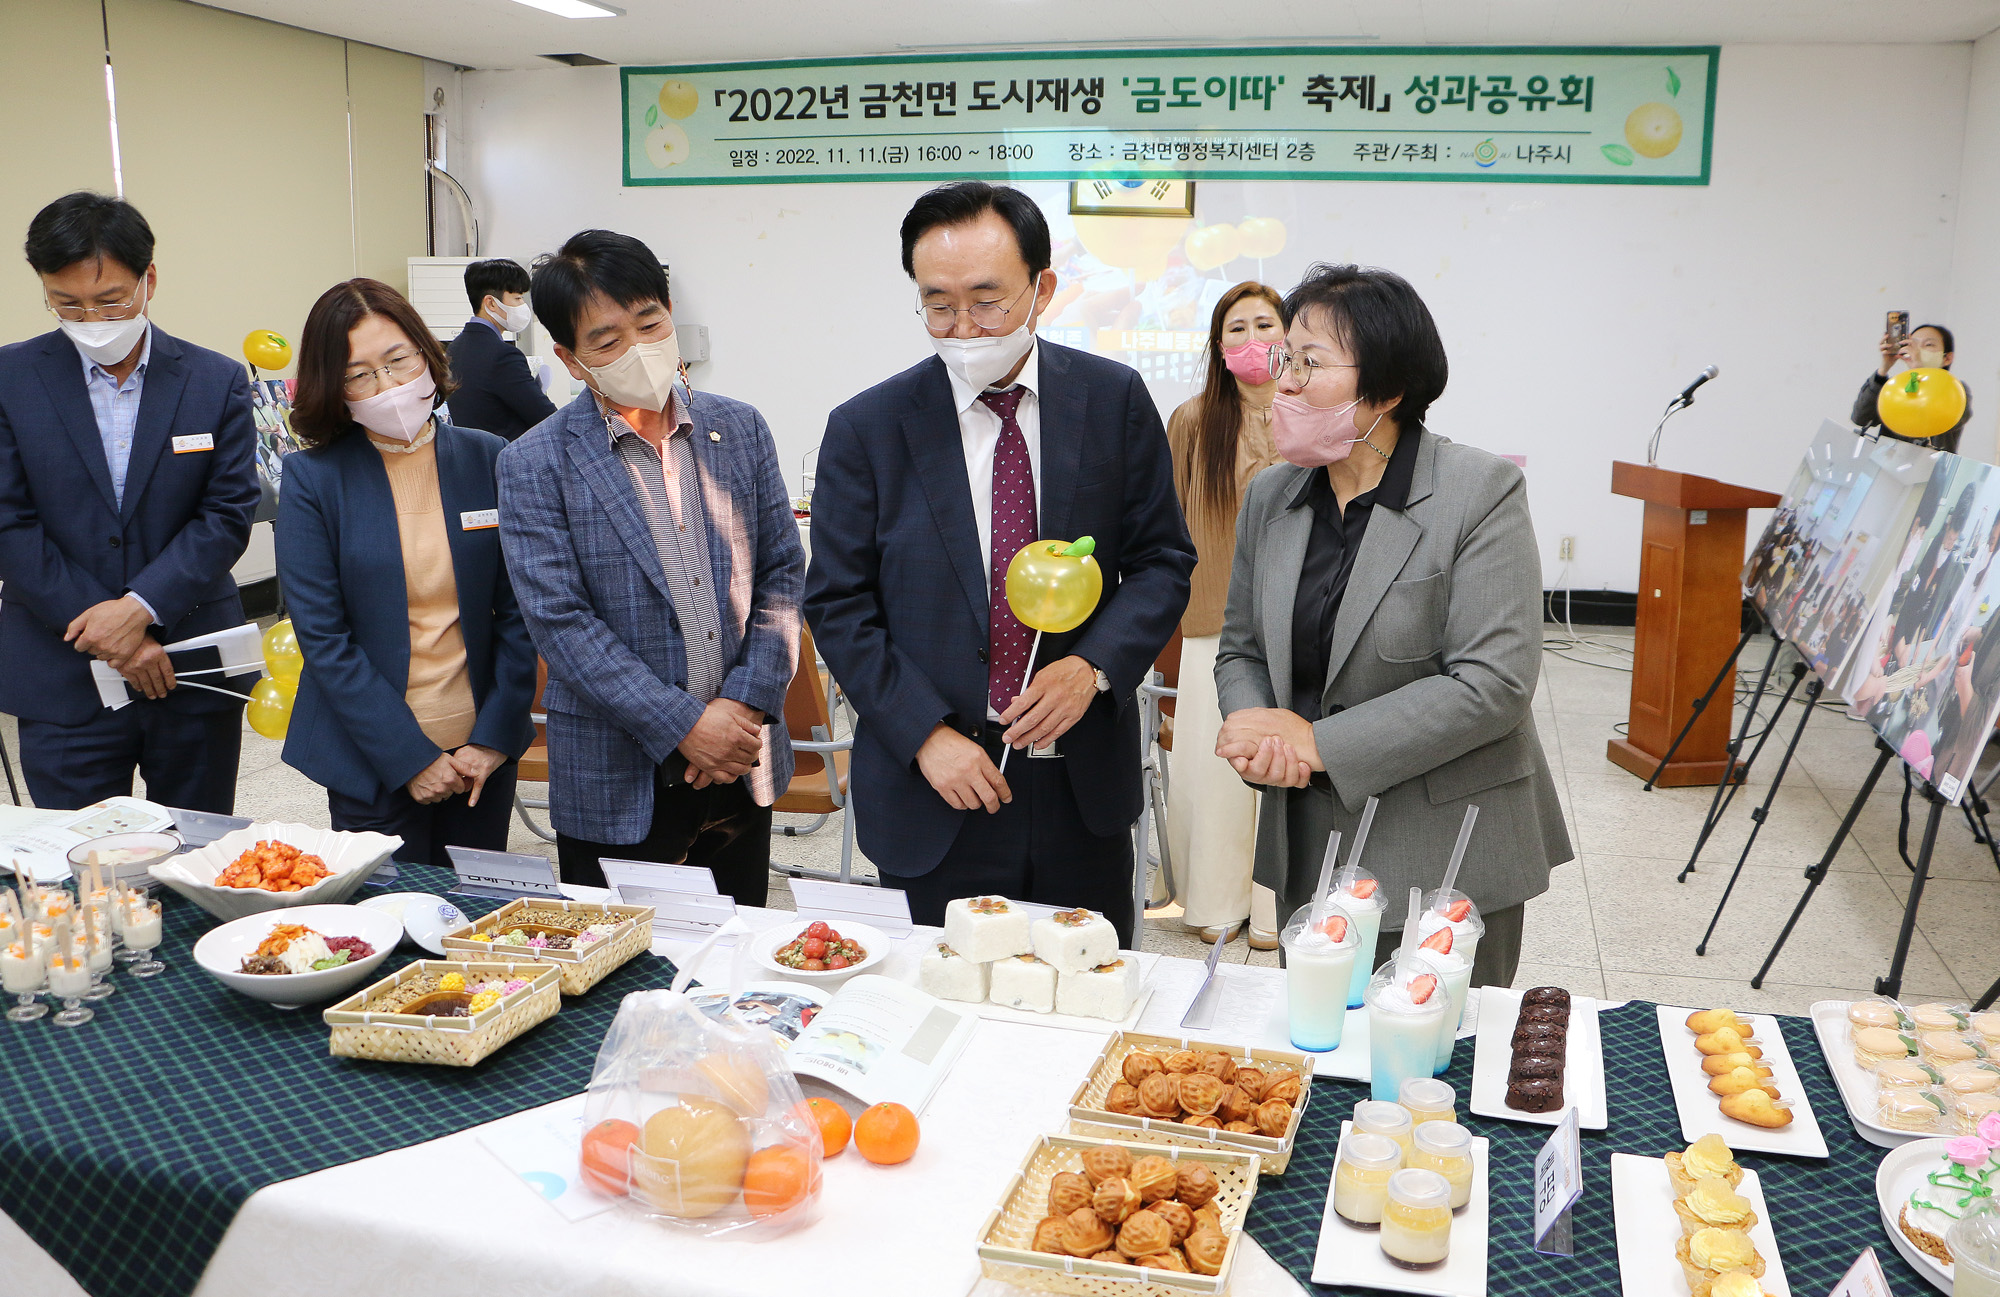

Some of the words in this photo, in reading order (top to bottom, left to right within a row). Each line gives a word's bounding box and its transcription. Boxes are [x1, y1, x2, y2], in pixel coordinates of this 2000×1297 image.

[859, 80, 957, 119] 금천면
[967, 76, 1105, 115] 도시재생
[1404, 74, 1595, 115] 성과공유회
[729, 149, 759, 167] 일정
[776, 149, 820, 165] 2022.
[918, 145, 962, 162] 16:00
[989, 144, 1034, 161] 18:00
[1068, 142, 1103, 162] 장소
[1122, 141, 1279, 162] 금천면행정복지센터
[1286, 141, 1316, 162] 2층
[1353, 142, 1438, 163] 주관/주최
[1516, 144, 1571, 164] 나주시
[1539, 1170, 1555, 1214] 푸딩
